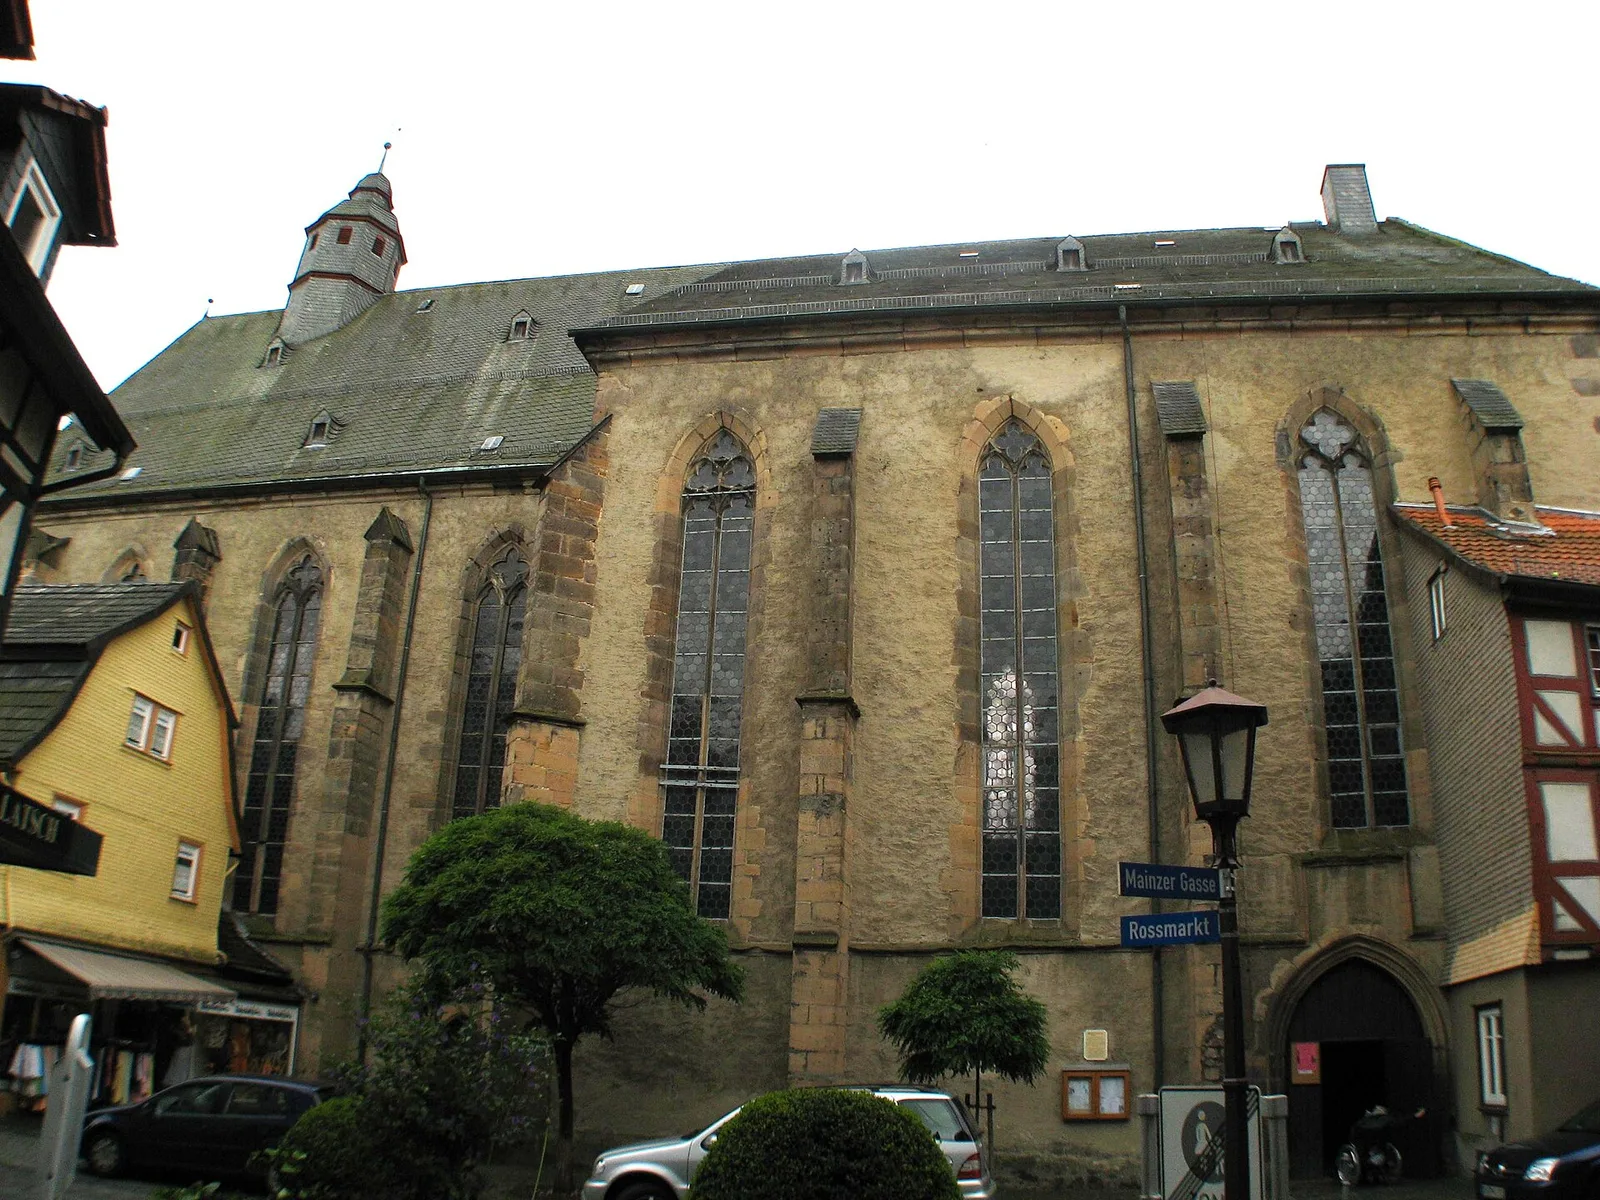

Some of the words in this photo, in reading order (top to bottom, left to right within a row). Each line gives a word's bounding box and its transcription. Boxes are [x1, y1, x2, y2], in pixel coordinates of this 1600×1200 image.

[1125, 868, 1175, 891] Mainzer
[1180, 872, 1216, 893] Gasse
[1129, 917, 1210, 940] Rossmarkt
